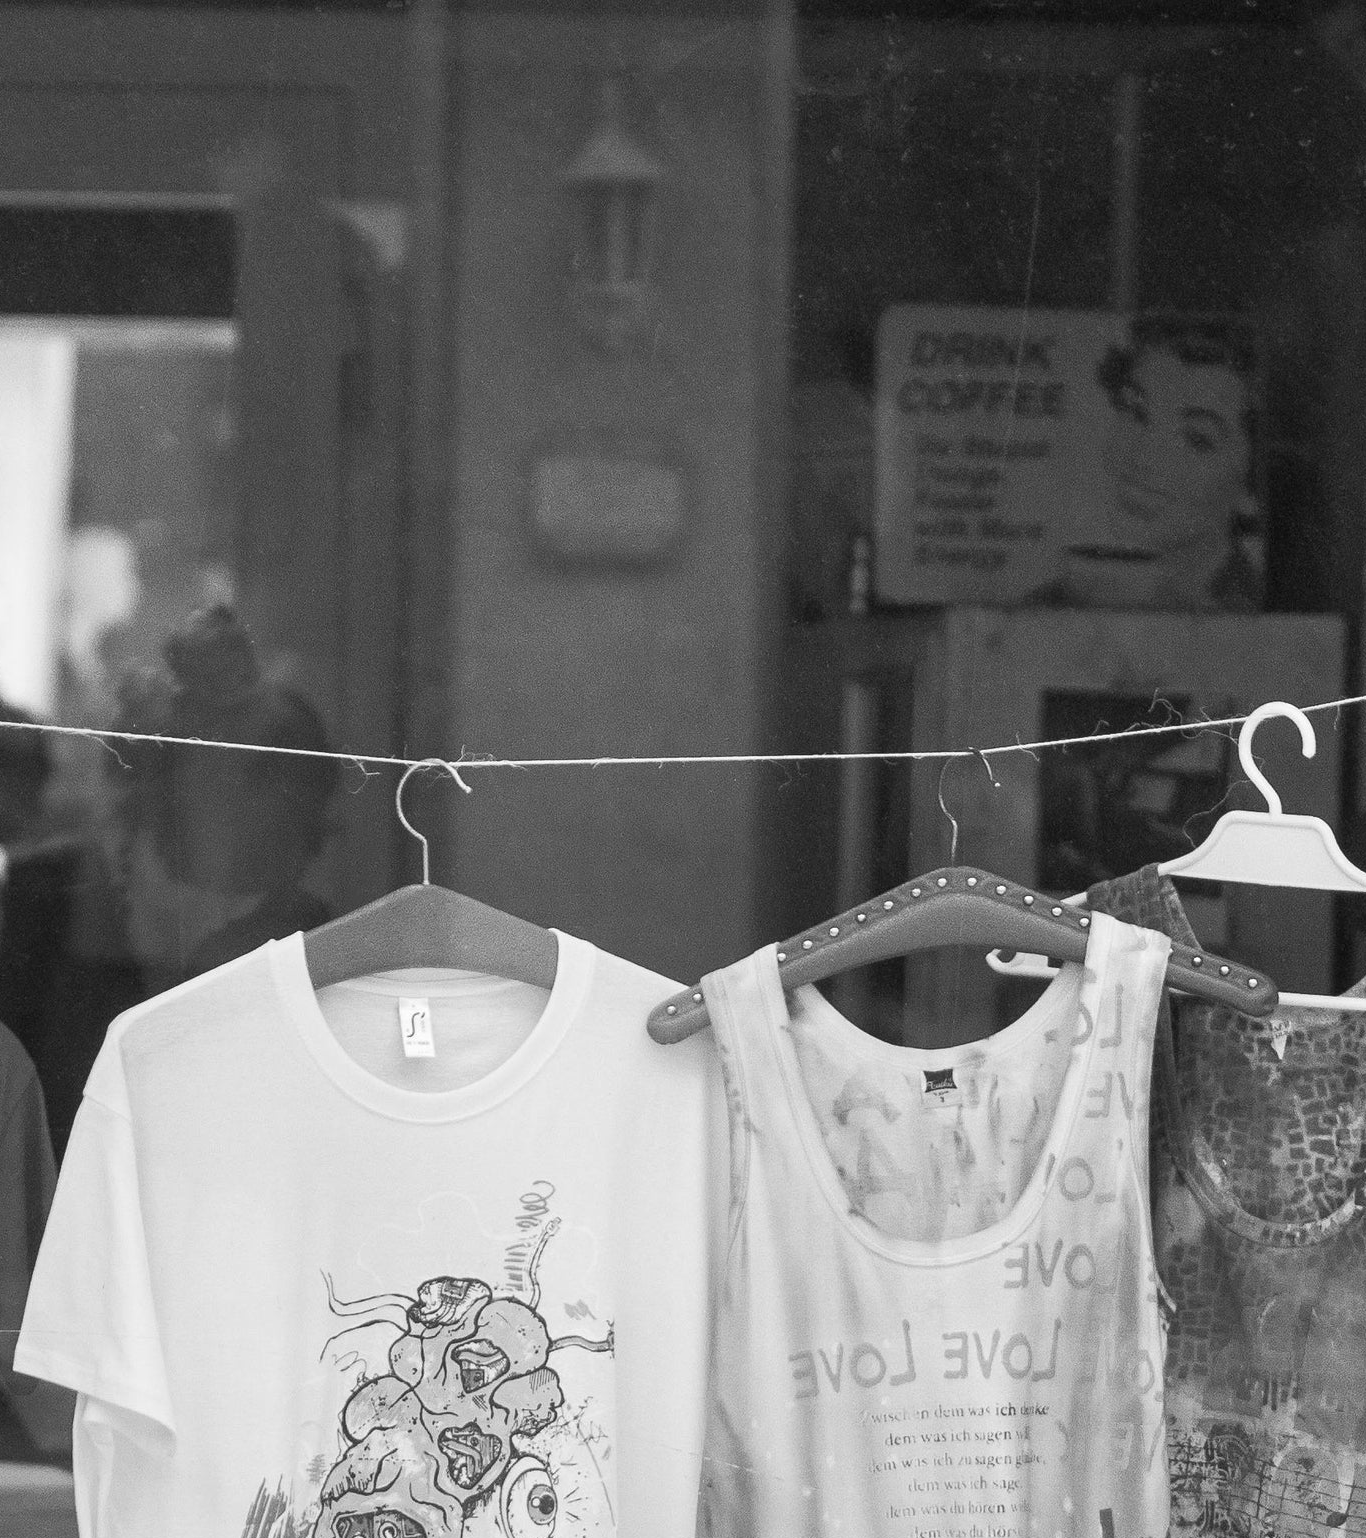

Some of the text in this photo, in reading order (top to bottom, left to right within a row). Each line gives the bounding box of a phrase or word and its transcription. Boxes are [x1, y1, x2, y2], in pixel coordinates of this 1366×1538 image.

[898, 378, 1066, 418] COFFEE
[933, 1404, 965, 1419] dem
[995, 1402, 1017, 1417] ich
[920, 1430, 948, 1445] was
